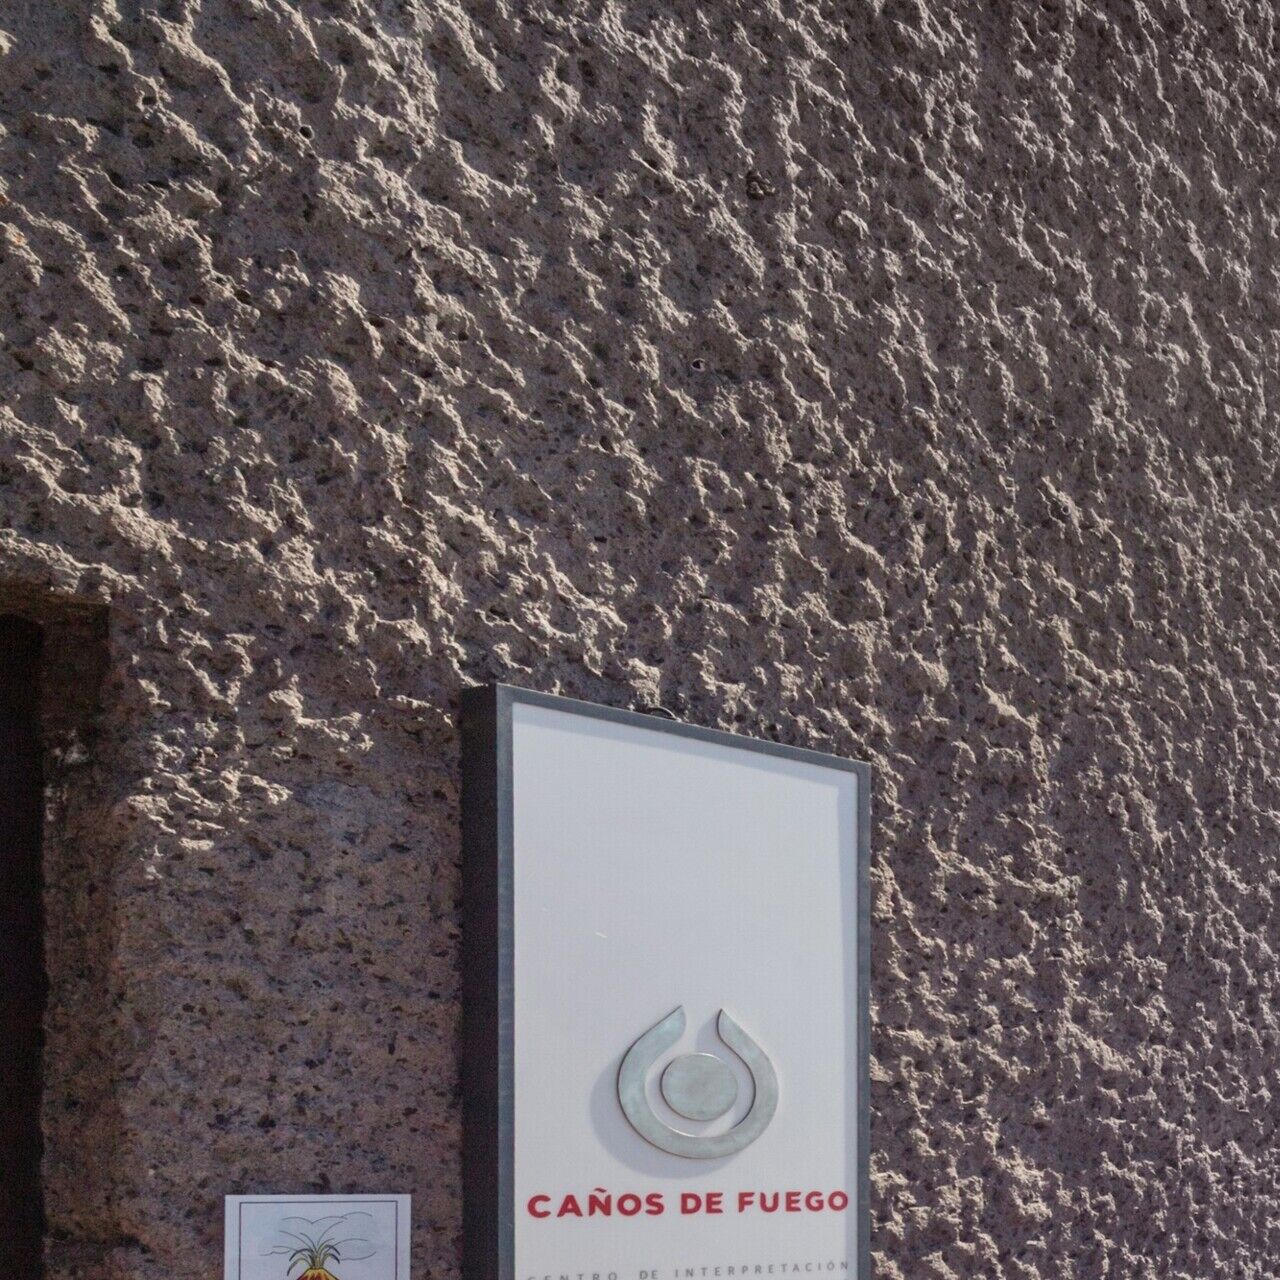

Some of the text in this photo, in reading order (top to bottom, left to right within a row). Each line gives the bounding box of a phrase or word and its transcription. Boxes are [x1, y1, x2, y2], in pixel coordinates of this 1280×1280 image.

[527, 1188, 849, 1219] CAÑOS DE FUEGO
[639, 1270, 659, 1280] DE
[674, 1259, 849, 1278] INTERPRETACIÓN
